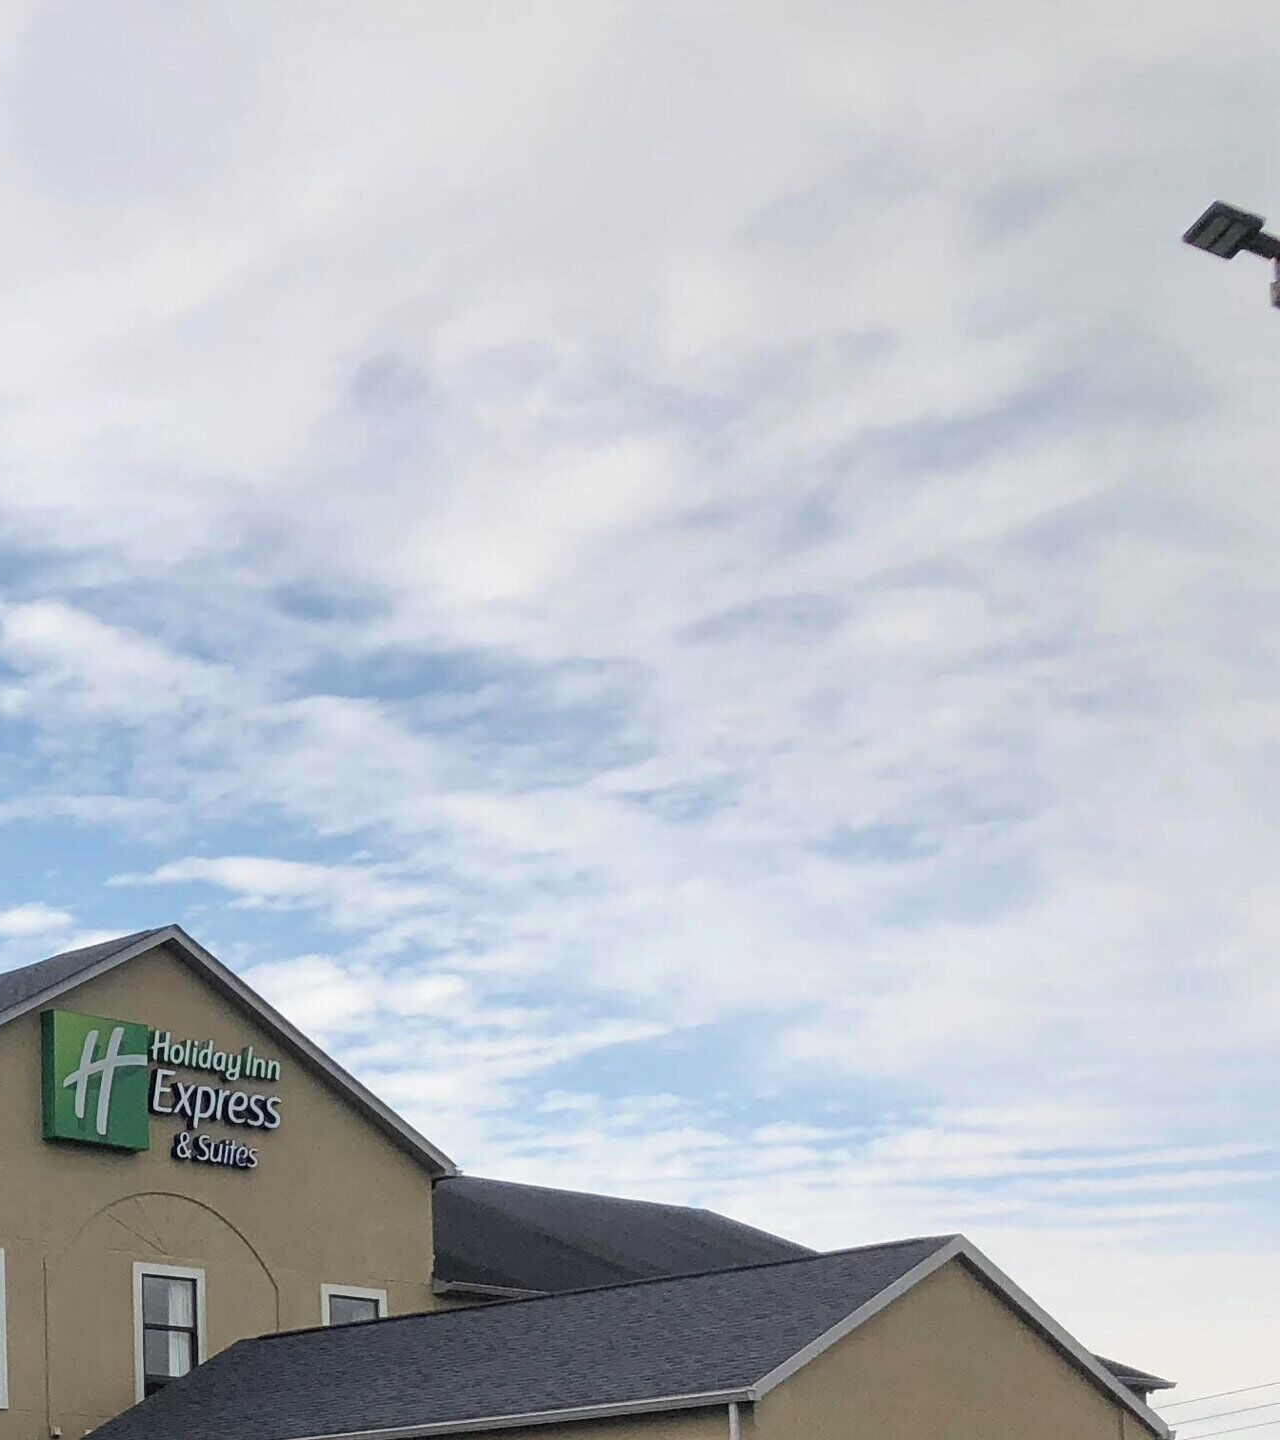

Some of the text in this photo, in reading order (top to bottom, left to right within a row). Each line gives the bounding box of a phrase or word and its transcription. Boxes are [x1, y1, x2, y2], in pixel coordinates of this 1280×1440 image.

[151, 1029, 281, 1081] Holiday Inn
[152, 1068, 282, 1129] Express
[176, 1132, 259, 1169] & Suites
